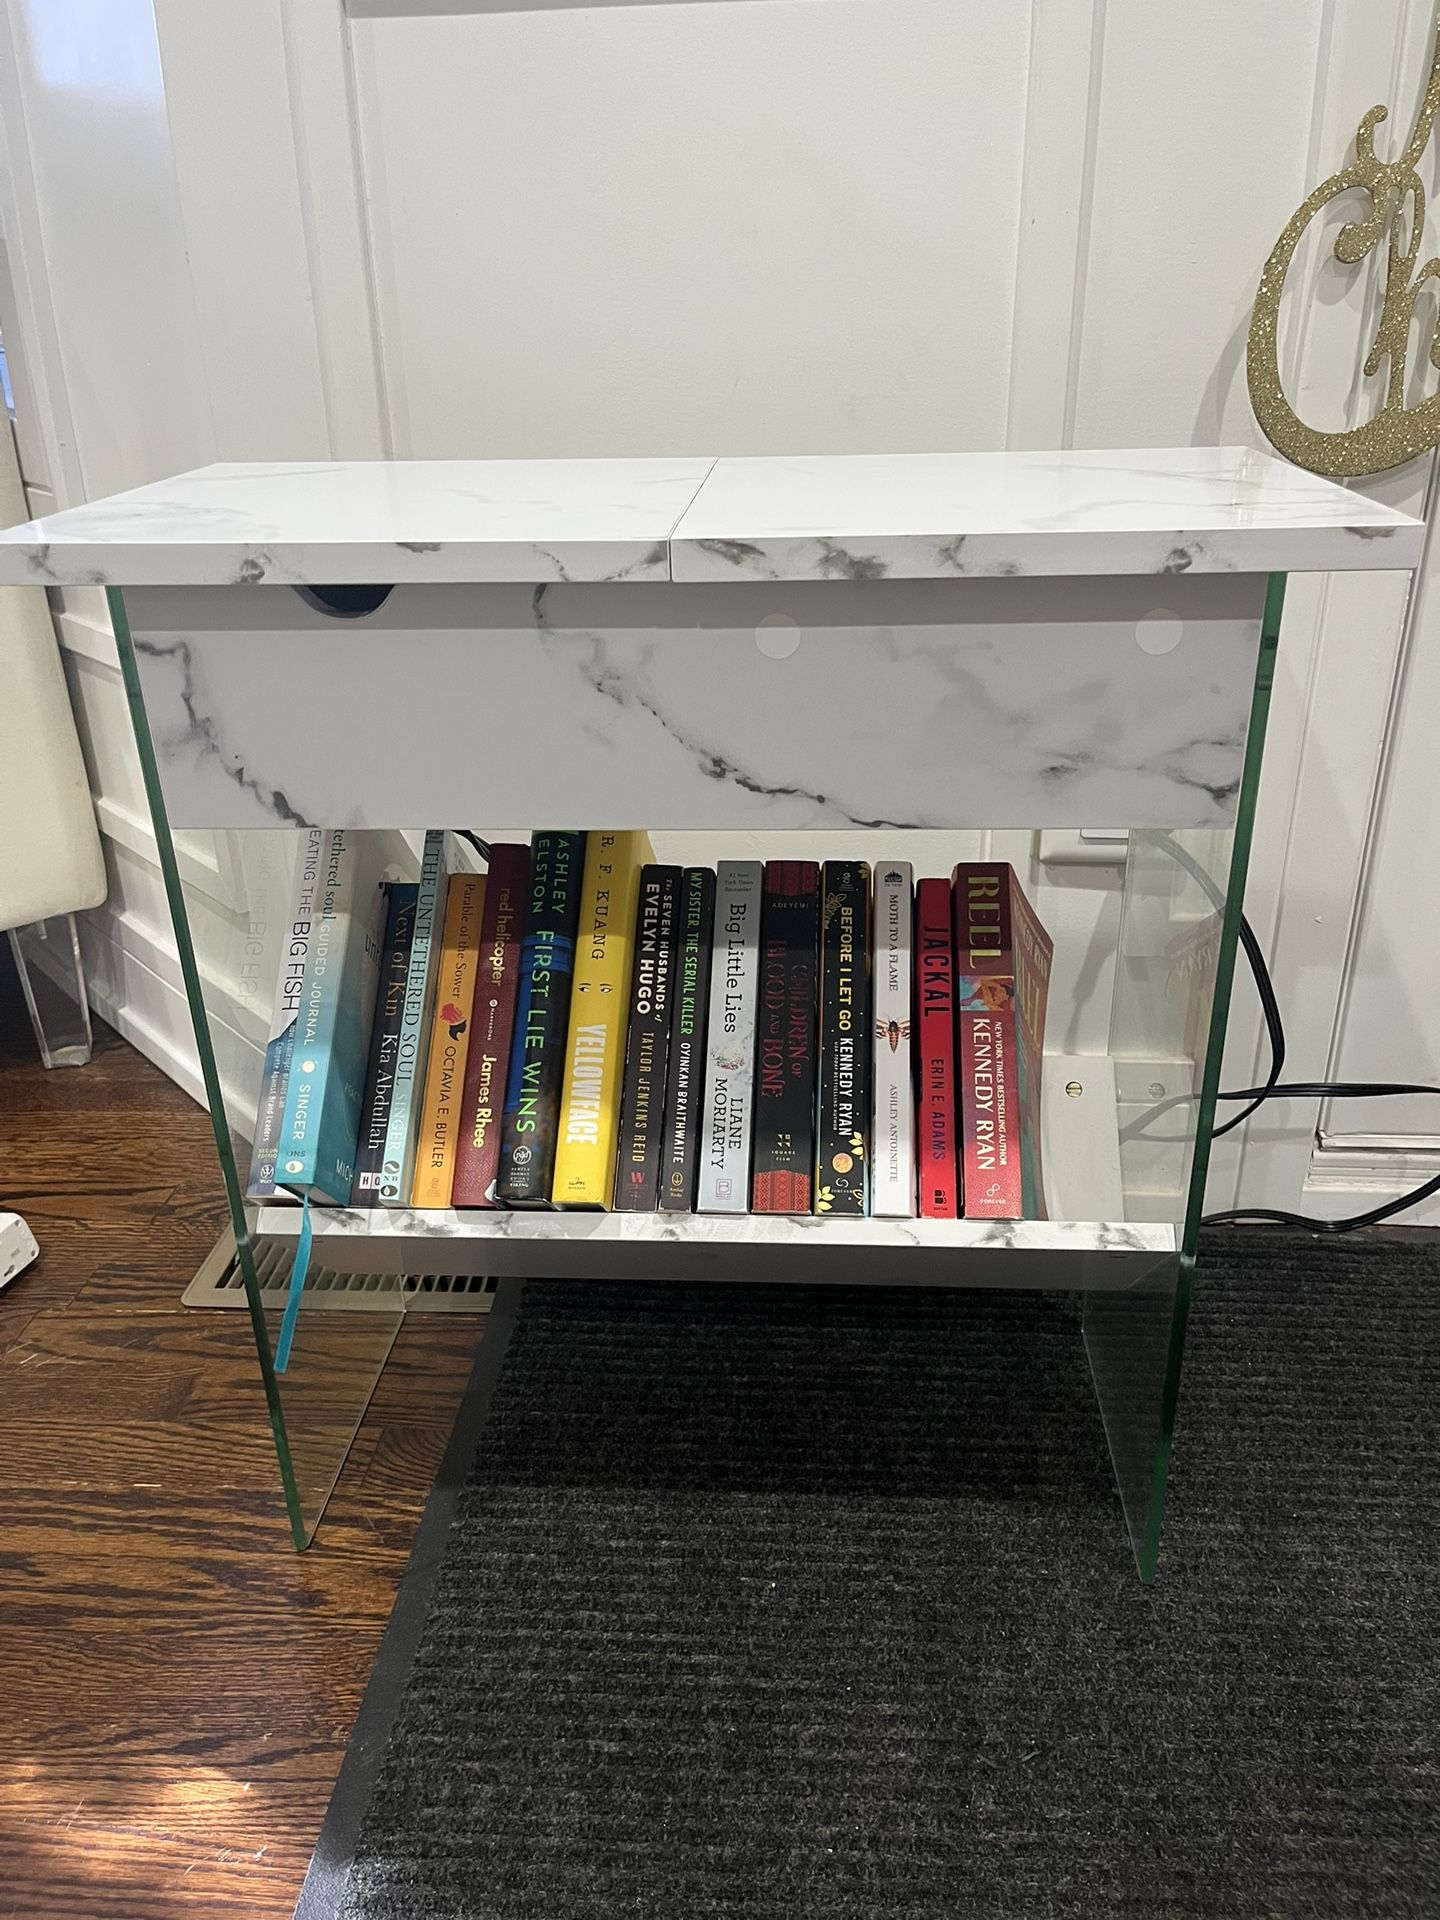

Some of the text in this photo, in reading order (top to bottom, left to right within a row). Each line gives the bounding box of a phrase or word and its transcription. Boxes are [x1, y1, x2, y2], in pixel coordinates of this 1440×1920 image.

[421, 849, 440, 887] THE
[531, 838, 549, 914] ELSTON
[552, 838, 570, 914] ASHLEY
[690, 872, 703, 889] MY
[282, 830, 322, 1011] EATING THE BIG FISH
[322, 891, 337, 921] soul
[461, 883, 476, 923] Parable
[592, 835, 615, 960] R. F. KUANG
[661, 894, 673, 936] SEVEN
[889, 894, 899, 926] MOTH
[968, 876, 1002, 969] REEL
[314, 924, 331, 977] GUIDED
[385, 901, 416, 1017] Next of Kin
[403, 894, 435, 1026] UNTETHERED
[457, 938, 470, 959] the
[460, 925, 471, 938] of
[637, 883, 660, 1015] EVELYN HUGO
[685, 932, 700, 953] THE
[839, 906, 853, 963] BEFORE
[889, 927, 899, 942] TO
[452, 963, 468, 999] Sower
[655, 940, 669, 1011] HUSBANDS
[682, 956, 698, 993] SERIAL
[724, 903, 746, 1033] Big Little Lies
[838, 978, 852, 1005] LET
[888, 953, 899, 992] FLAME
[923, 926, 950, 1017] JACKAL
[303, 982, 323, 1046] JOURNAL
[516, 930, 555, 1133] FIRST LIE WINS
[680, 997, 696, 1035] KILLER
[838, 1009, 852, 1031] GO
[397, 1033, 417, 1086] SOUL
[440, 1046, 457, 1103] OCTAVIA
[566, 1024, 607, 1145] YELLOWFACE
[762, 1039, 787, 1098] BONE
[838, 1037, 854, 1136] KENNEDY RYAN
[266, 1095, 277, 1114] Brand
[292, 1084, 312, 1141] SINGER
[368, 1033, 399, 1149] Kia Abdullah
[436, 1108, 449, 1119] E.
[473, 1054, 497, 1149] James Rhee
[631, 1032, 655, 1162] TAYLOR JENKINS REID
[672, 1042, 692, 1164] OYINKAN BRAITHWAITE
[931, 1058, 946, 1160] ERIN E. ADAMS
[973, 1018, 996, 1170] KENNEDY RYAN
[994, 1021, 1008, 1166] NEW YORK TIMES BESTSELLING AUTHOR
[263, 1116, 274, 1142] Leaders
[391, 1093, 406, 1151] SINGER
[431, 1122, 447, 1168] BUTLER
[711, 1077, 728, 1170] MORIARTY
[729, 1097, 743, 1149] LIANE
[889, 1084, 899, 1183] ASHLEY ANTOINETTE
